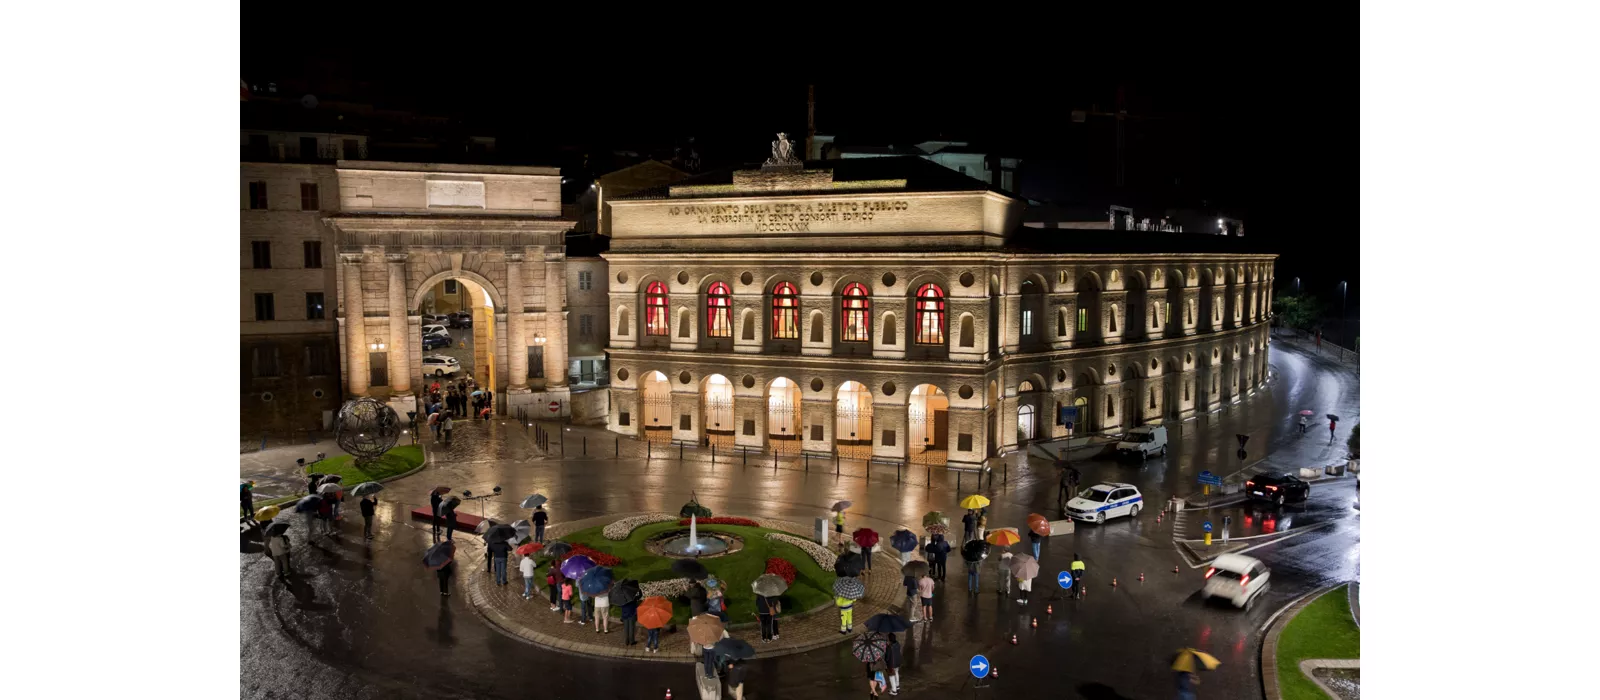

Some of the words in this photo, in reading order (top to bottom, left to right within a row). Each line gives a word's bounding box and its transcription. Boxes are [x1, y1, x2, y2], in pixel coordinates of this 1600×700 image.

[668, 206, 680, 216] AD
[684, 205, 739, 215] ORNAMENTO
[744, 204, 771, 214] DELLA
[806, 204, 813, 213] A
[818, 202, 858, 212] DILETTO
[863, 201, 908, 211] PUBBLICO
[698, 215, 708, 223] LA
[757, 214, 765, 222] DI
[769, 213, 794, 222] CENTO
[799, 212, 838, 221] CONSORTI
[755, 222, 809, 232] MDCCCXXIX
